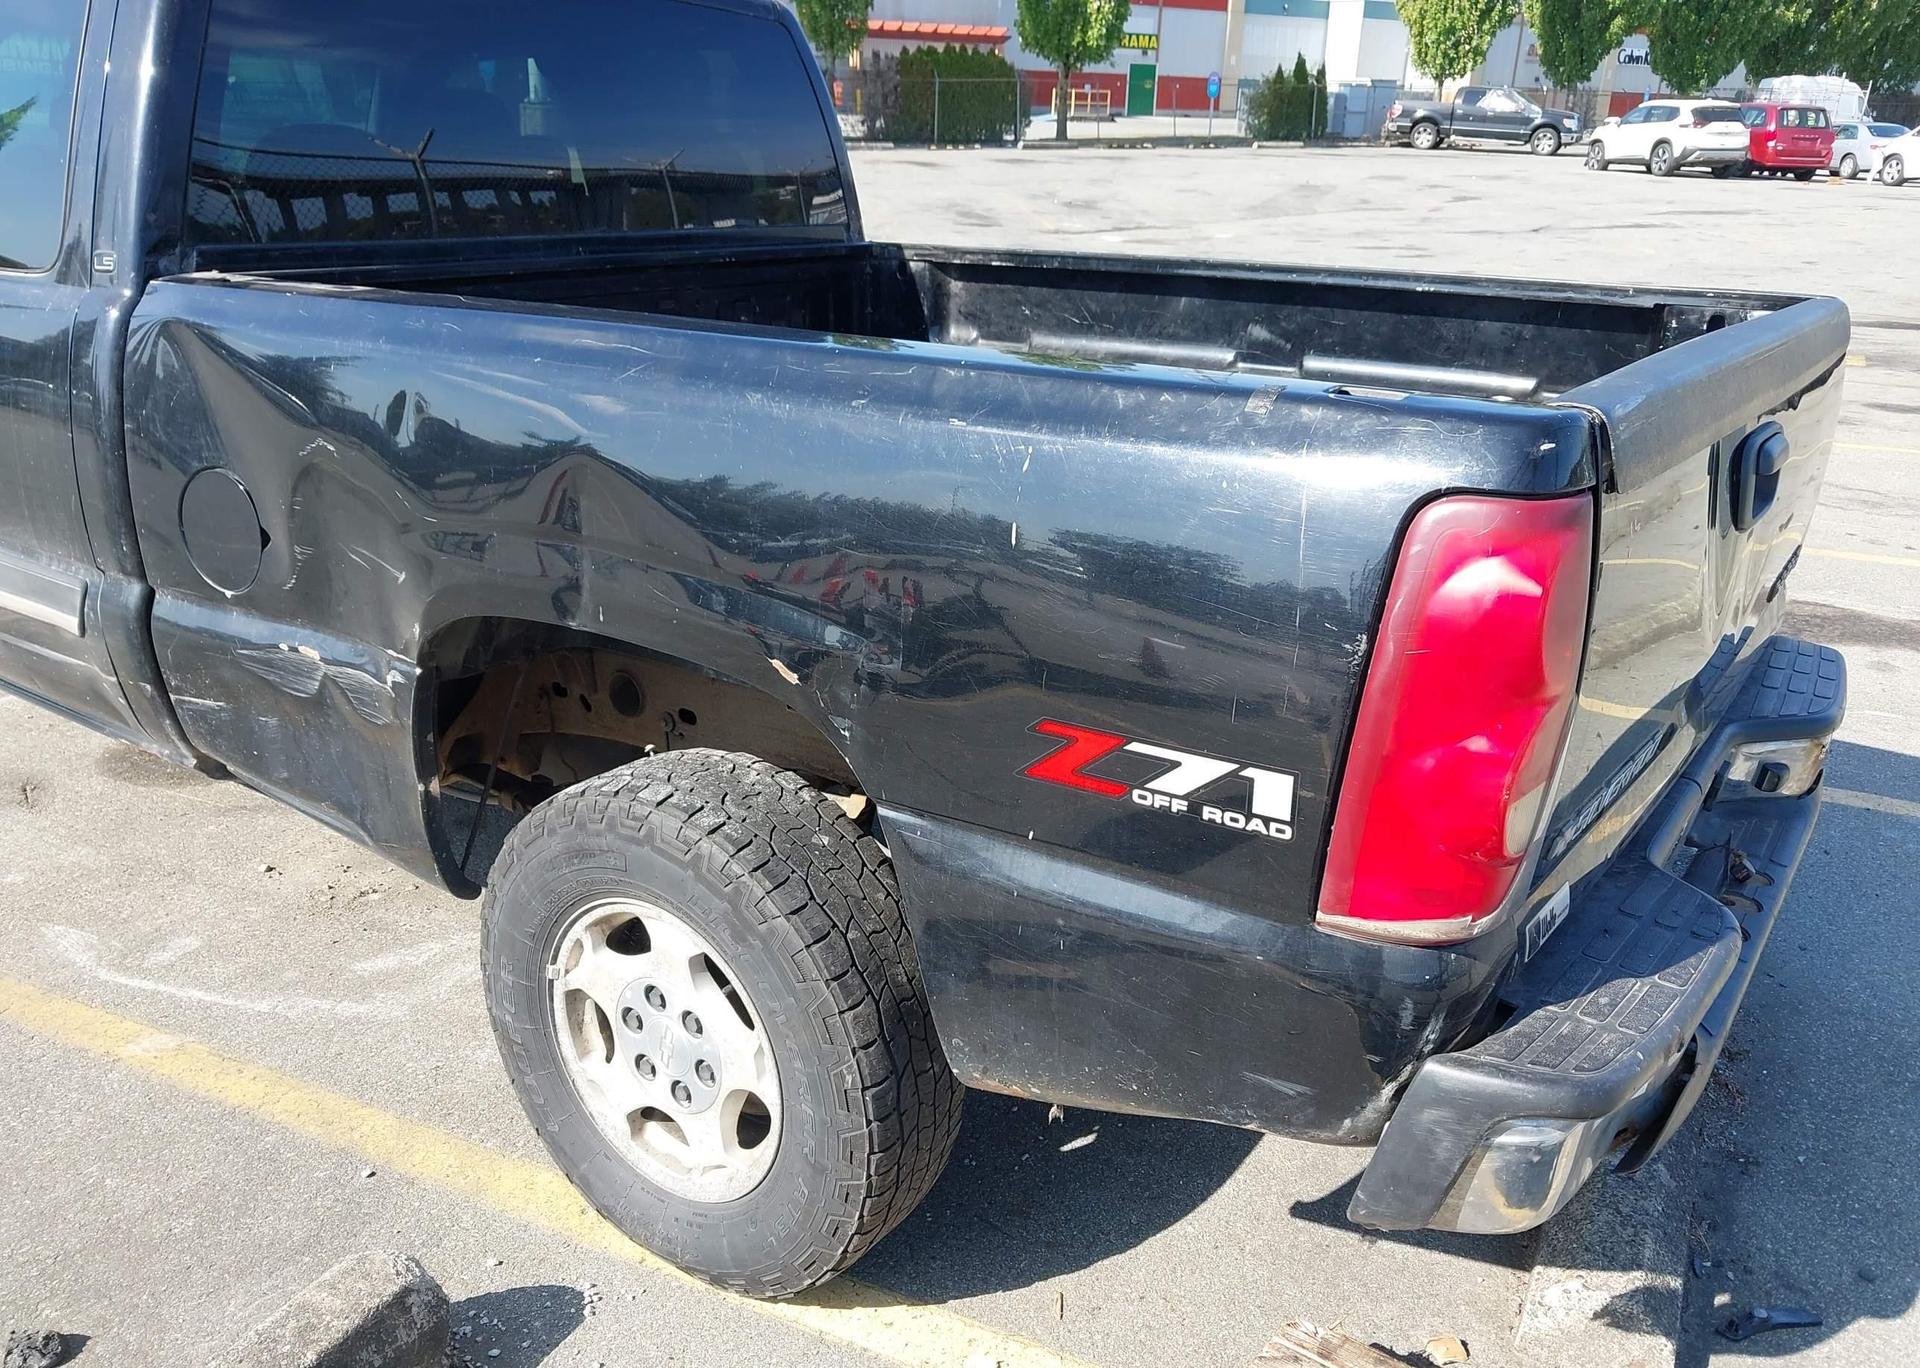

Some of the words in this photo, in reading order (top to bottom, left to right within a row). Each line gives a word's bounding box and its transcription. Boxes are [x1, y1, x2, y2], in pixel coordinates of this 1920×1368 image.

[1617, 48, 1643, 65] Calvin
[94, 256, 114, 270] LS
[1024, 719, 1295, 822] Z71
[1131, 788, 1189, 813] OFF
[1202, 805, 1293, 841] ROAD
[499, 954, 560, 1133] COOPER
